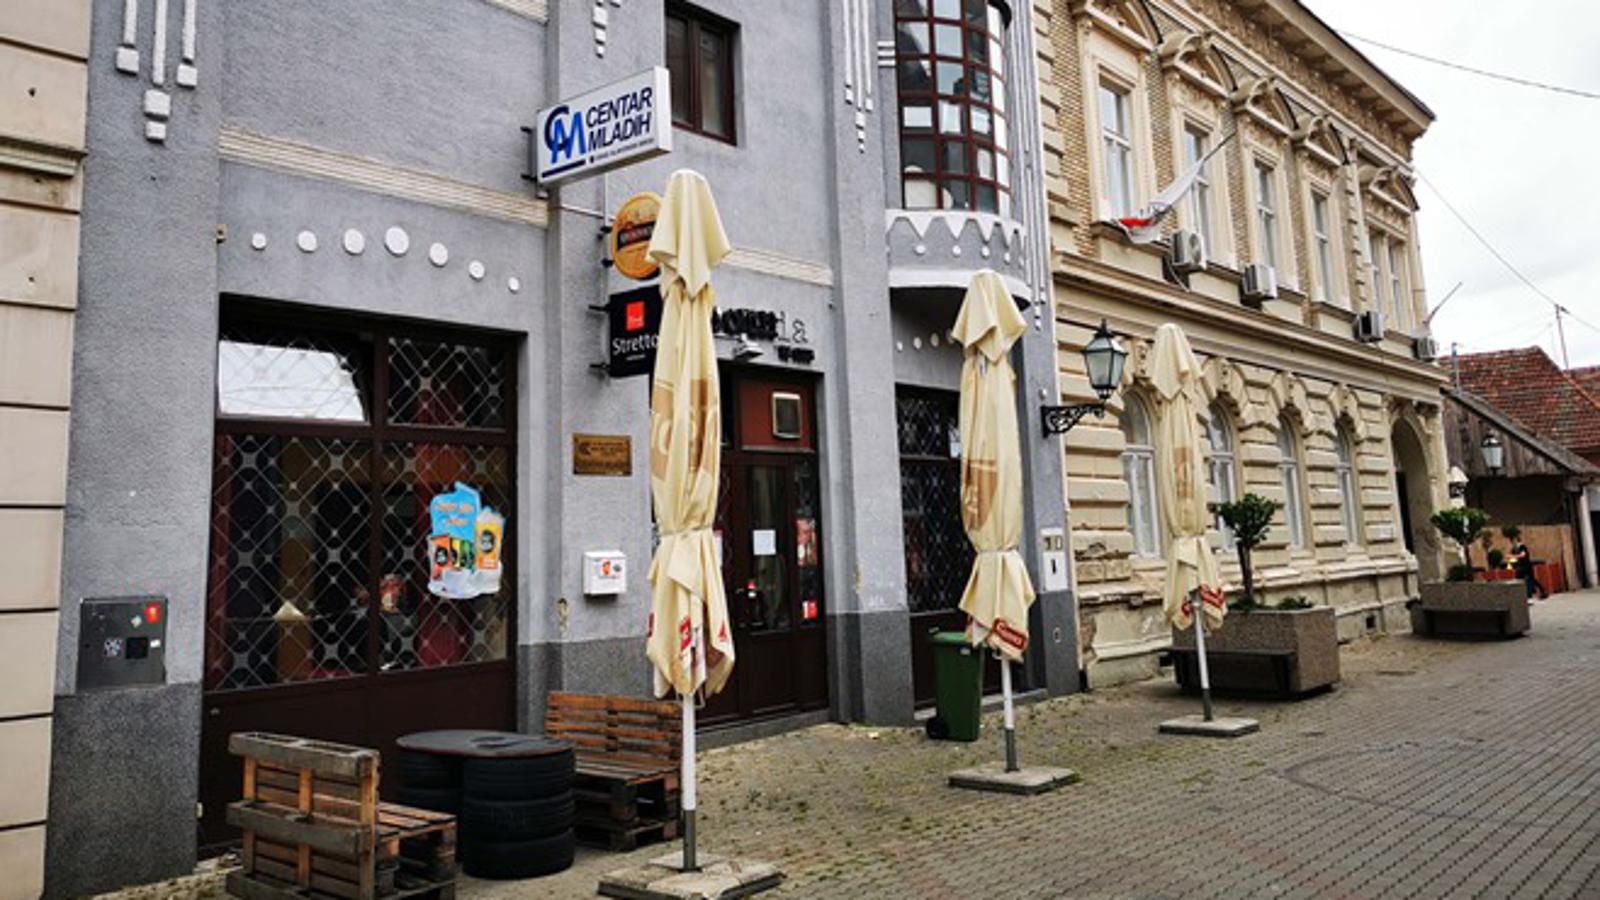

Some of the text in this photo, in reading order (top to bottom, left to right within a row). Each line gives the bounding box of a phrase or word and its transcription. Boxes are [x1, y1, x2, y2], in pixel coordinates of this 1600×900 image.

[586, 87, 653, 128] CENTAR
[588, 111, 652, 152] MLADIH
[612, 333, 659, 355] Stretto
